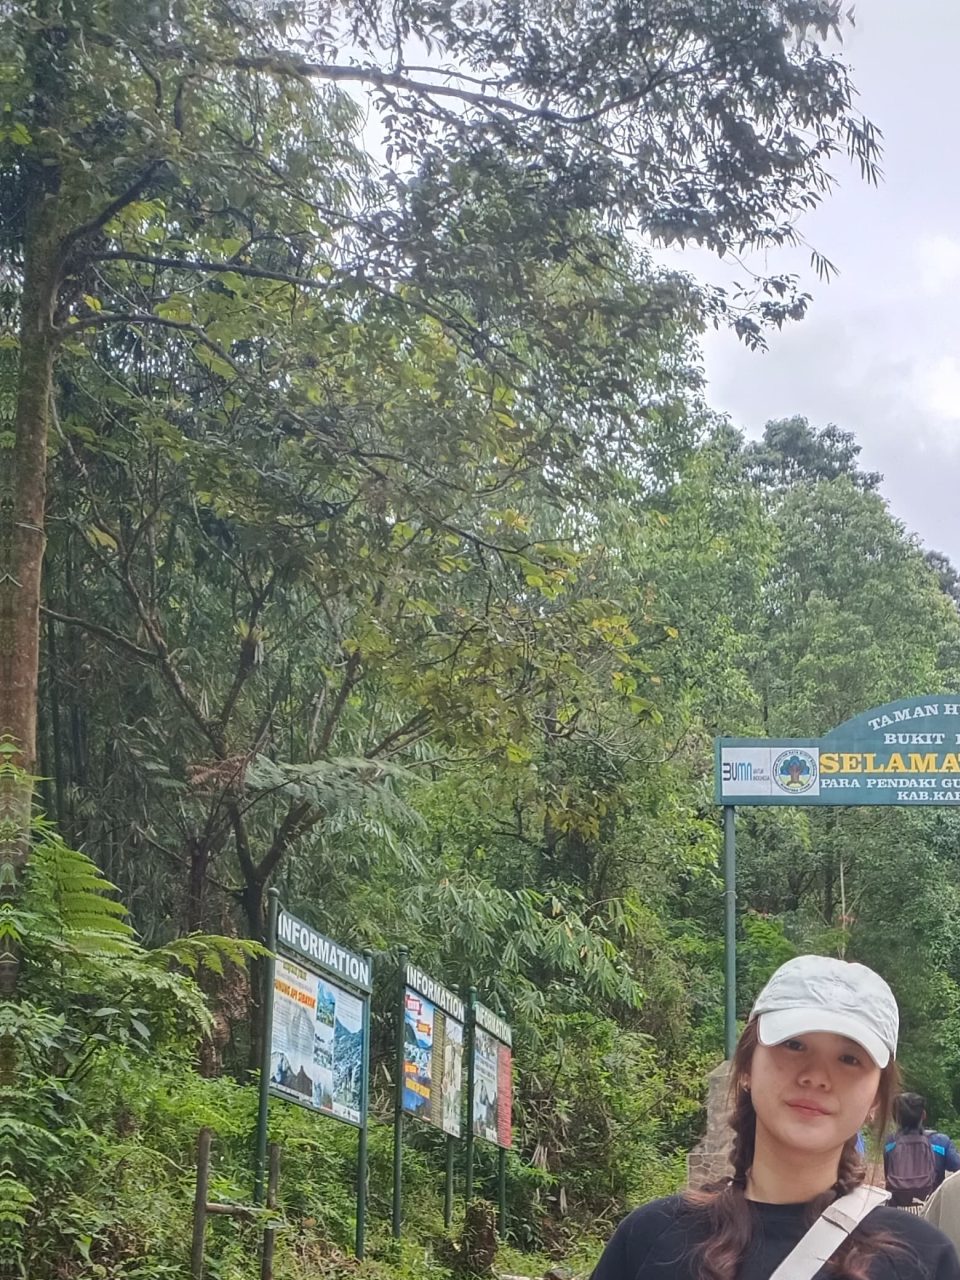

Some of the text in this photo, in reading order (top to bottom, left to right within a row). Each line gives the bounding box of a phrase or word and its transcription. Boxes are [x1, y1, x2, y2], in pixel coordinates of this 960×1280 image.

[867, 703, 939, 731] TAMAN
[883, 733, 945, 745] BUKIT
[820, 778, 861, 788] PARA
[866, 778, 937, 788] PENDAKI
[278, 912, 369, 986] INFORMATION
[406, 964, 465, 1023] INFORMATION
